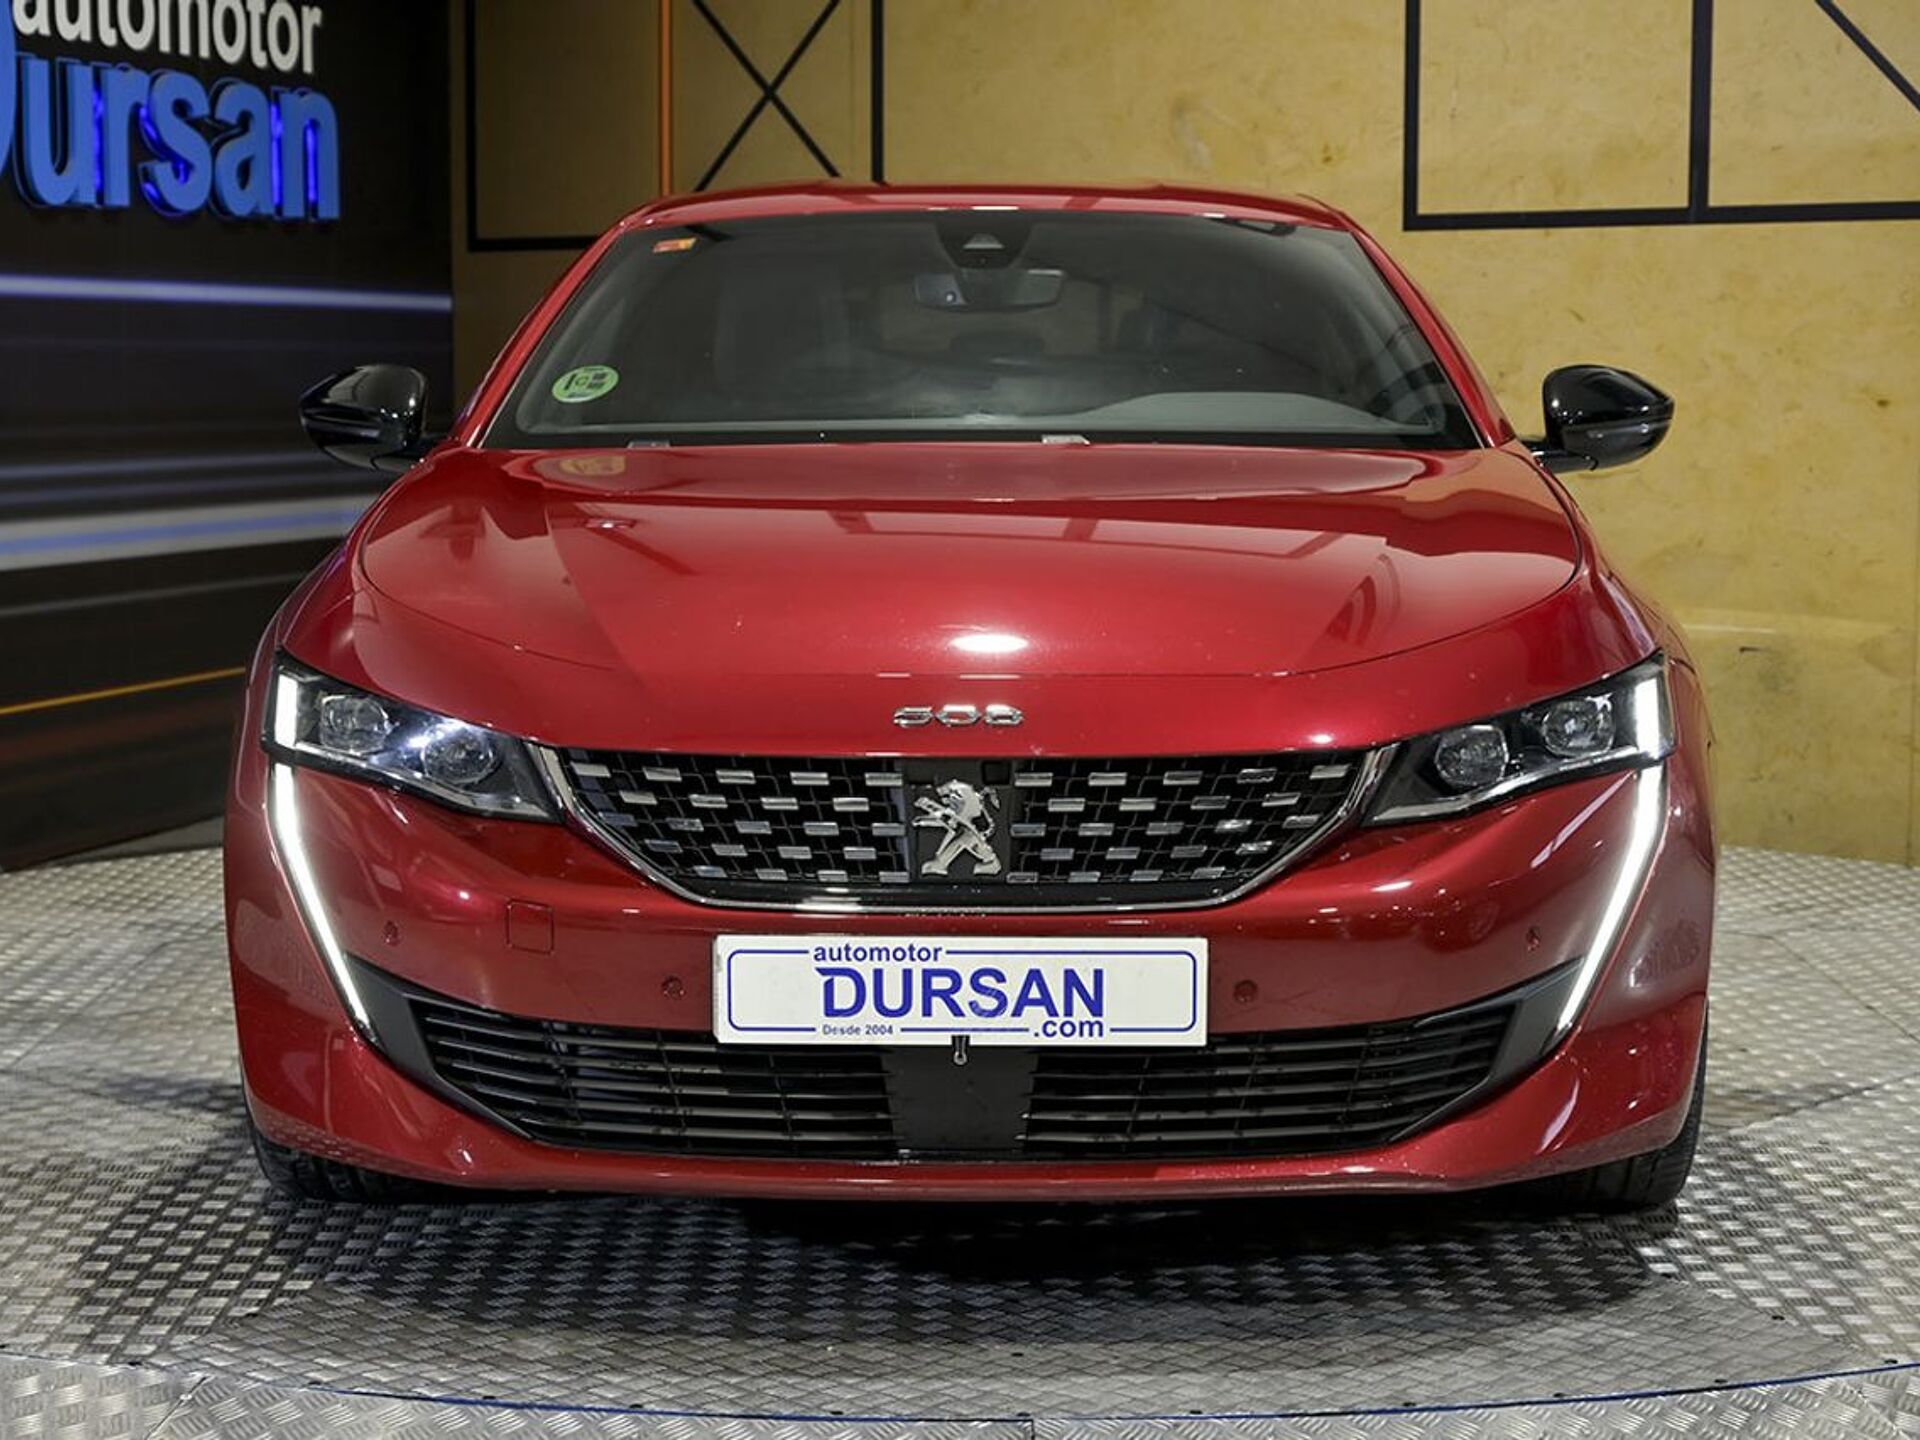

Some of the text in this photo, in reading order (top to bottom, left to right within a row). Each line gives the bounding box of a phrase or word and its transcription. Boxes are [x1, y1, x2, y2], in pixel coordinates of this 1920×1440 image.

[0, 0, 340, 219] ursan
[813, 943, 943, 962] automotor
[815, 967, 1104, 1018] DURSAN
[822, 1023, 894, 1035] Desde 2004
[1033, 1019, 1104, 1038] .com
